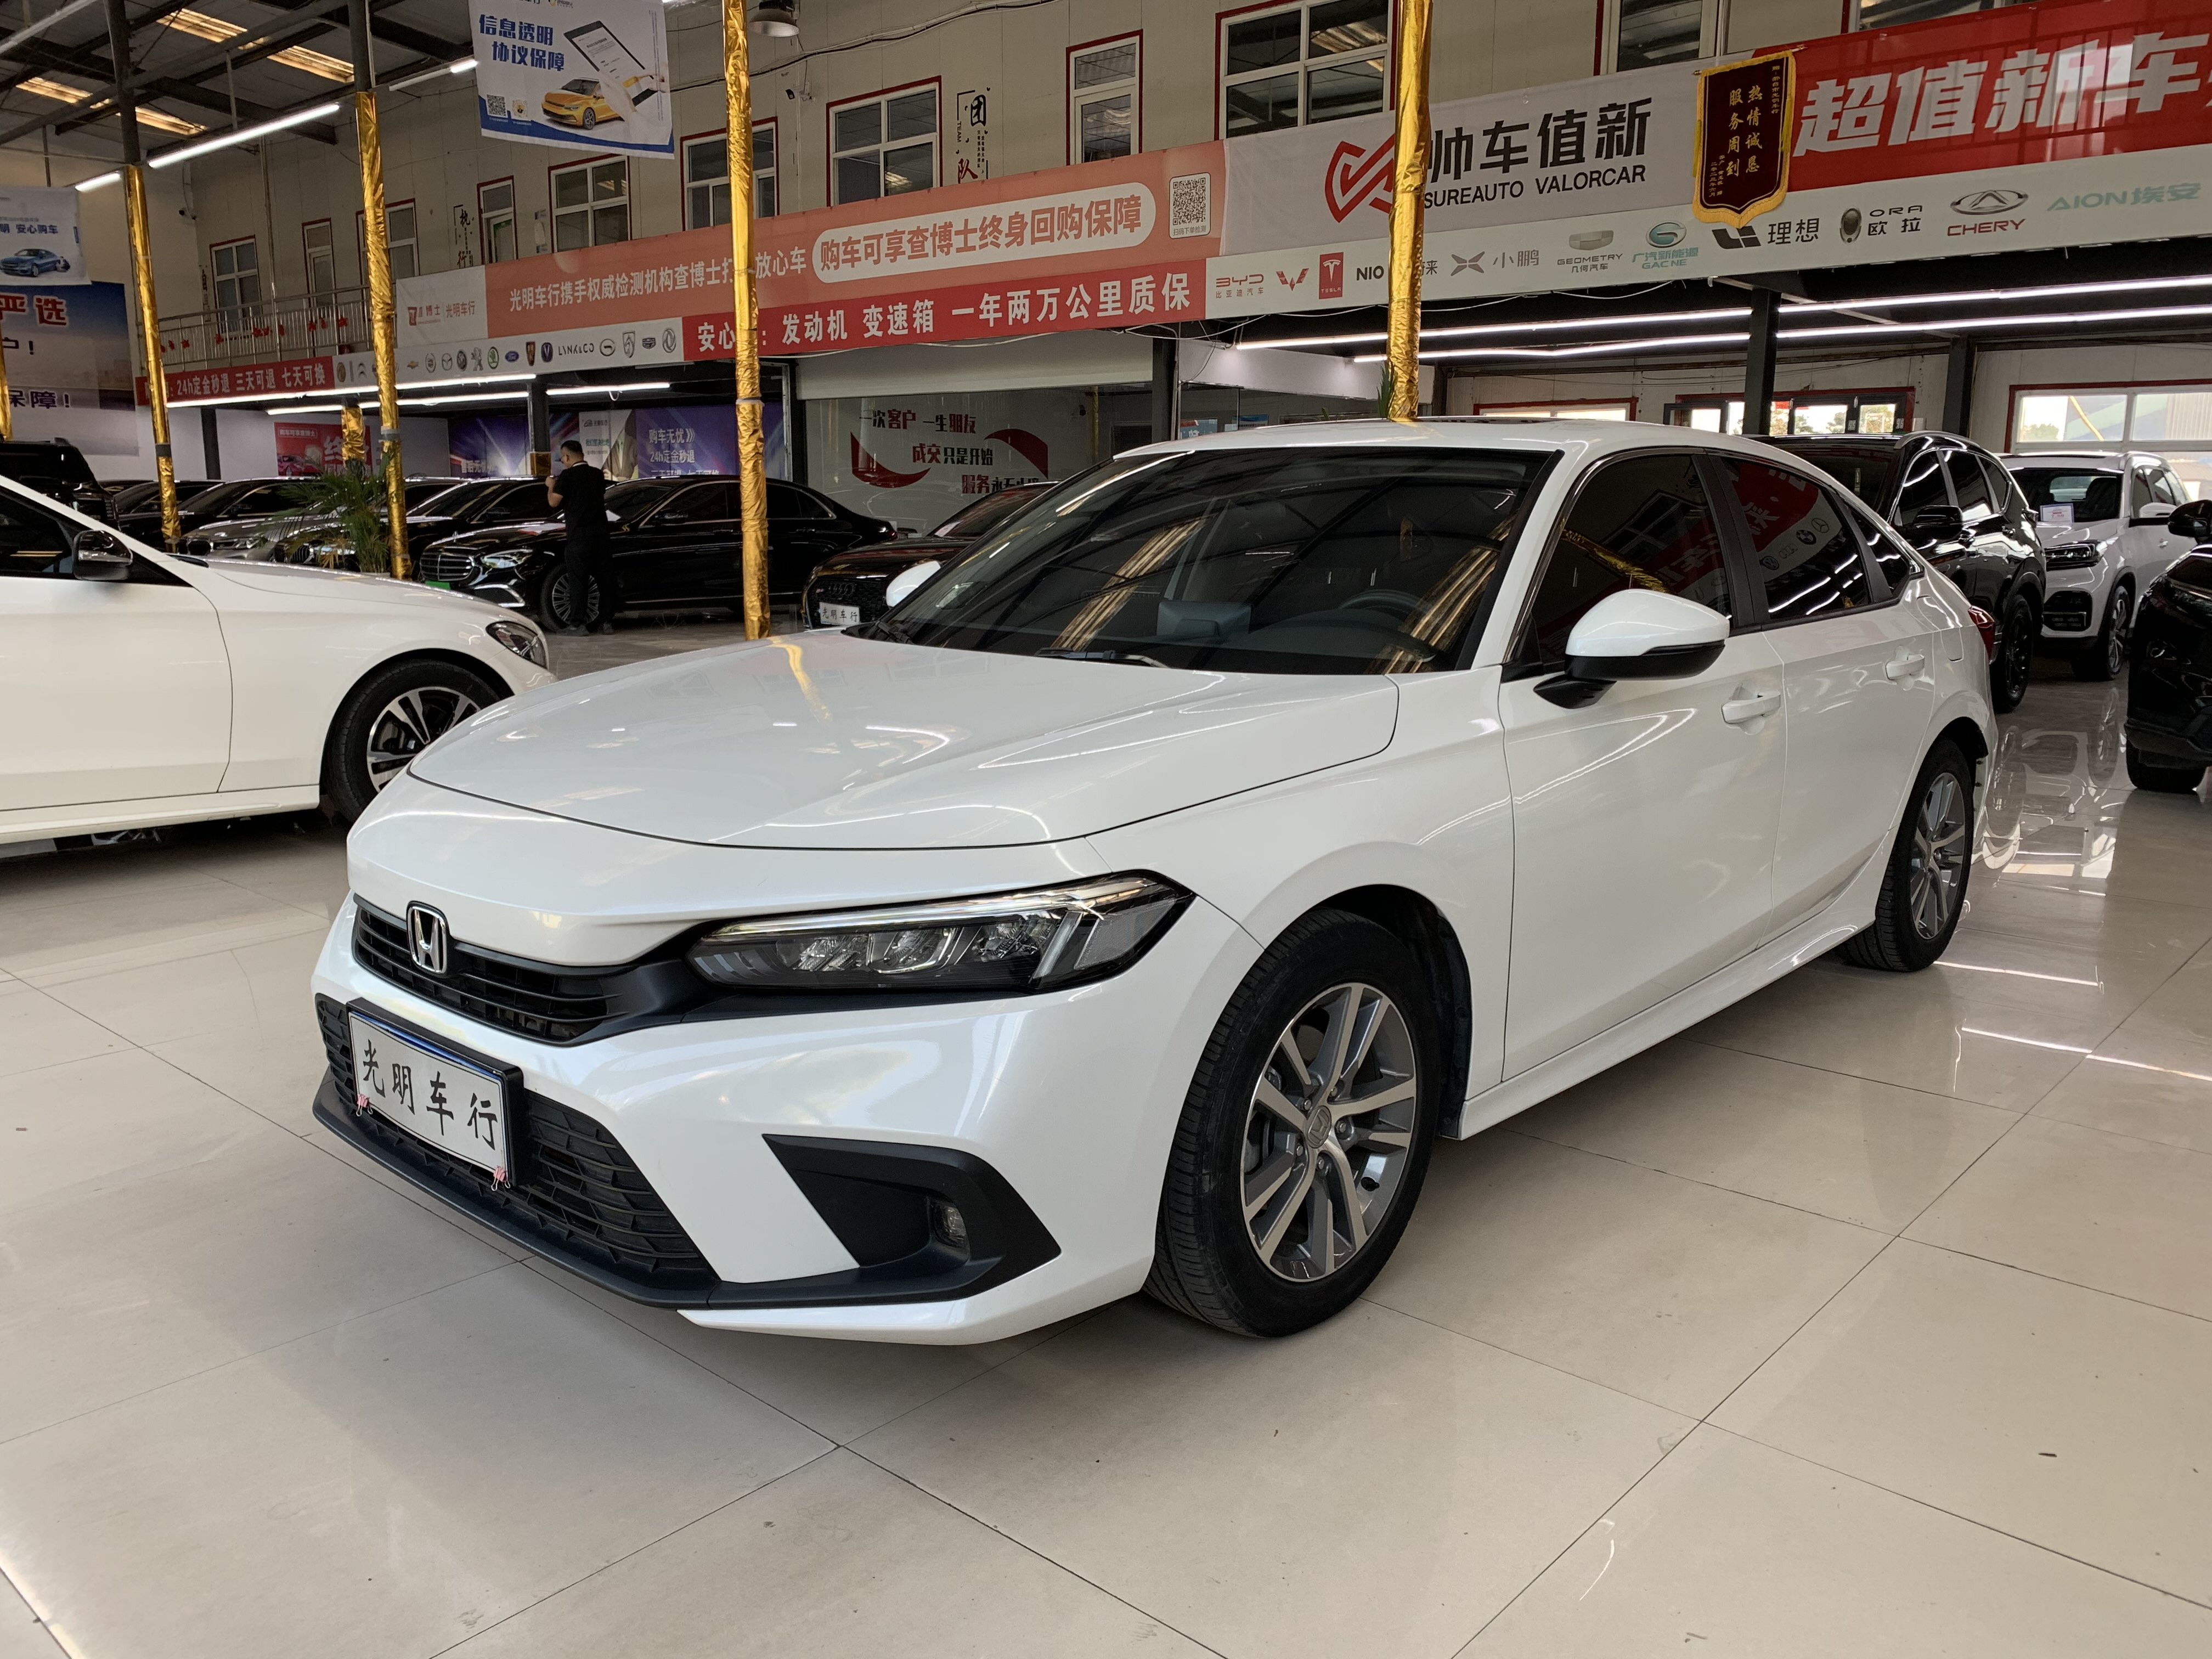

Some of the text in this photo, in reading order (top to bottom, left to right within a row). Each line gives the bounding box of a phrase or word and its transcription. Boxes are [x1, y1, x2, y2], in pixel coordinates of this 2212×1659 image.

[479, 14, 554, 46] 信息透明
[492, 41, 565, 71] 协议保障
[1794, 31, 2212, 156] 超值新车
[1726, 88, 1744, 177] 服务周到
[1745, 85, 1763, 173] 热情诚恳
[1428, 97, 1652, 183] 帅车值新
[1424, 165, 1646, 208] SUREAUTO VALORCAR
[1870, 205, 1923, 217] ORA
[16, 224, 59, 234] 安心购车
[821, 194, 1142, 273] 购车可享查博士终身回购保障
[1173, 225, 1206, 236] 扫码下单检测
[1767, 218, 1820, 245] 理想
[1867, 217, 1922, 236] 欧拉
[1947, 218, 2027, 237] CHERY
[1493, 249, 1539, 268] 小鹏
[1557, 253, 1623, 265] GEOMETRY
[1632, 247, 1699, 263] 广汽新能源
[1641, 258, 1688, 270] GAC NE
[1356, 266, 1385, 281] NIO
[1571, 263, 1609, 273] 几何汽车
[510, 246, 806, 312] 光明车行携手权威检测机构查博士打放心车
[1216, 273, 1264, 288] BYD
[1215, 286, 1264, 298] 比亚迪汽车
[0, 295, 66, 325] 严选
[446, 301, 475, 318] 光明车行
[698, 272, 1190, 352] 安心： 发动机 变速箱 一年两万公里质保
[177, 373, 230, 396] 24h定金秒退
[235, 368, 276, 391] 三天可退
[281, 363, 325, 387] 七天可换
[859, 409, 976, 434] 一次客户 一生朋友
[649, 428, 684, 443] 购车无忧
[650, 449, 696, 463] 24h定金秒退
[912, 443, 994, 466] 成交只是开始
[961, 474, 1039, 494] 服务永无
[822, 607, 858, 623] 光明车行
[363, 1039, 498, 1151] 光明车行
